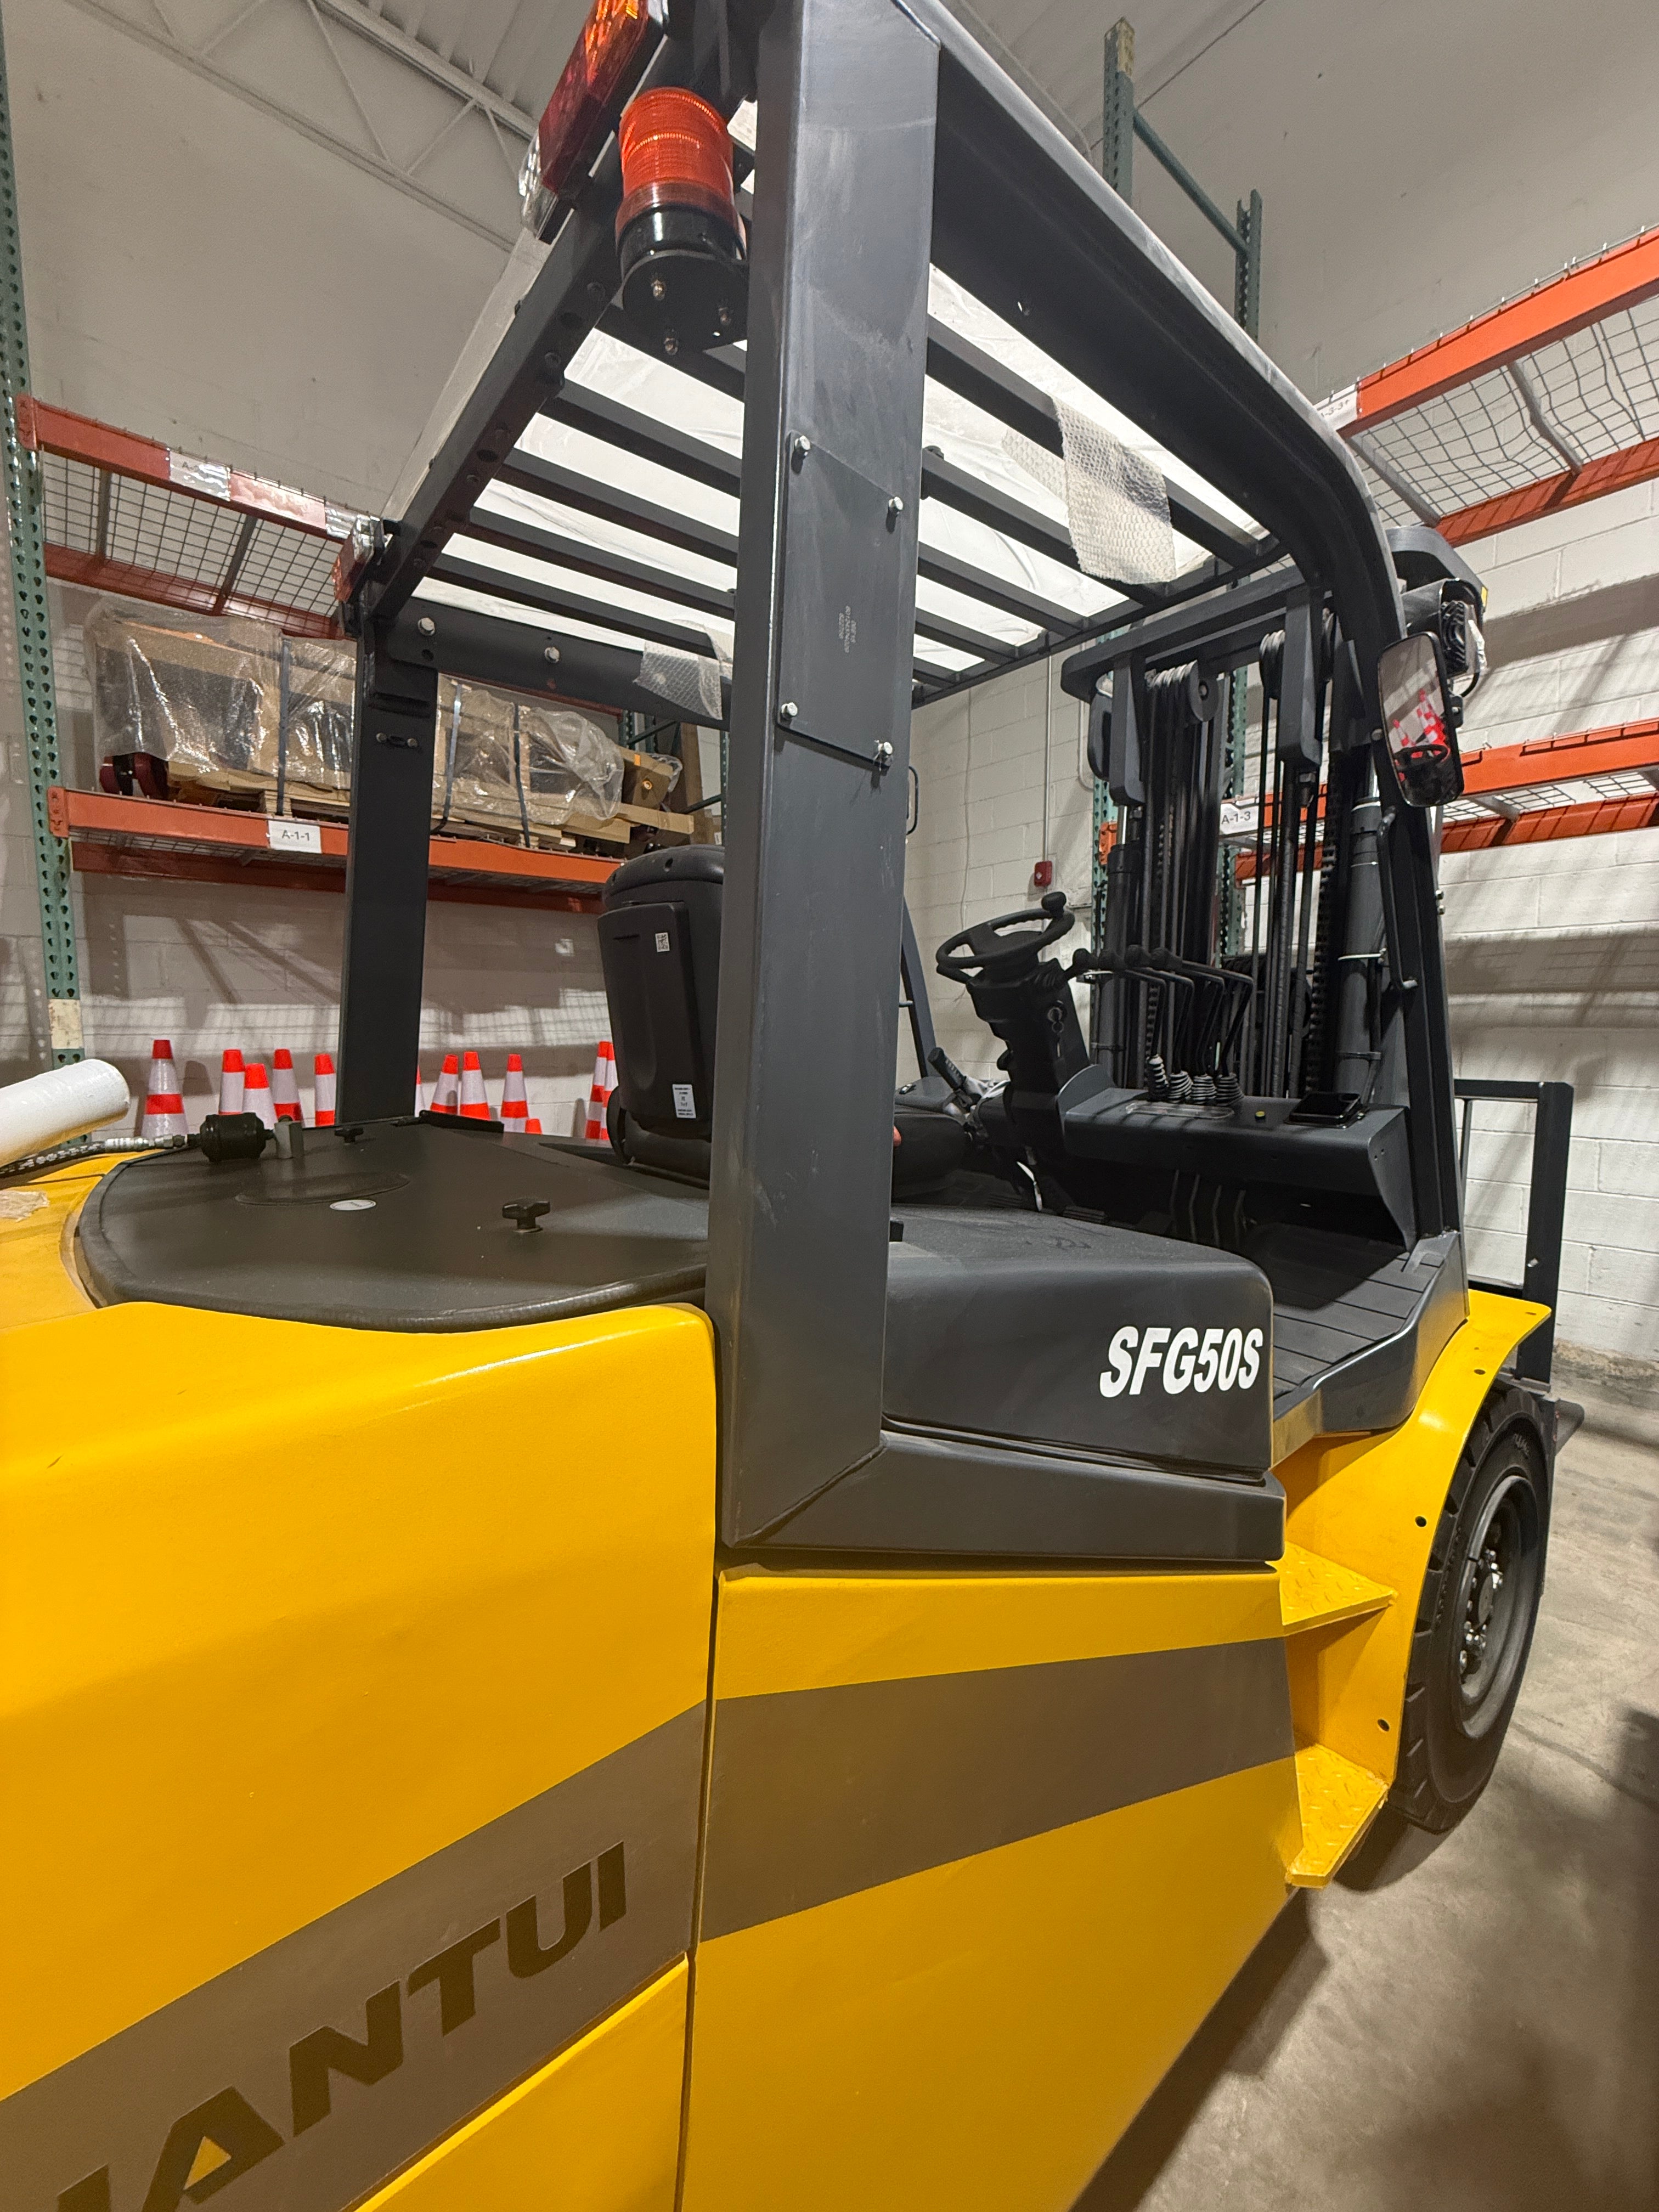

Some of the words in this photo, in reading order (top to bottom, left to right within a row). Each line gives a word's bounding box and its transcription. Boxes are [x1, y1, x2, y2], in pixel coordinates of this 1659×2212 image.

[1221, 811, 1251, 825] A-1-3
[281, 830, 310, 842] A-1-1
[1099, 1326, 1263, 1398] SFG50S
